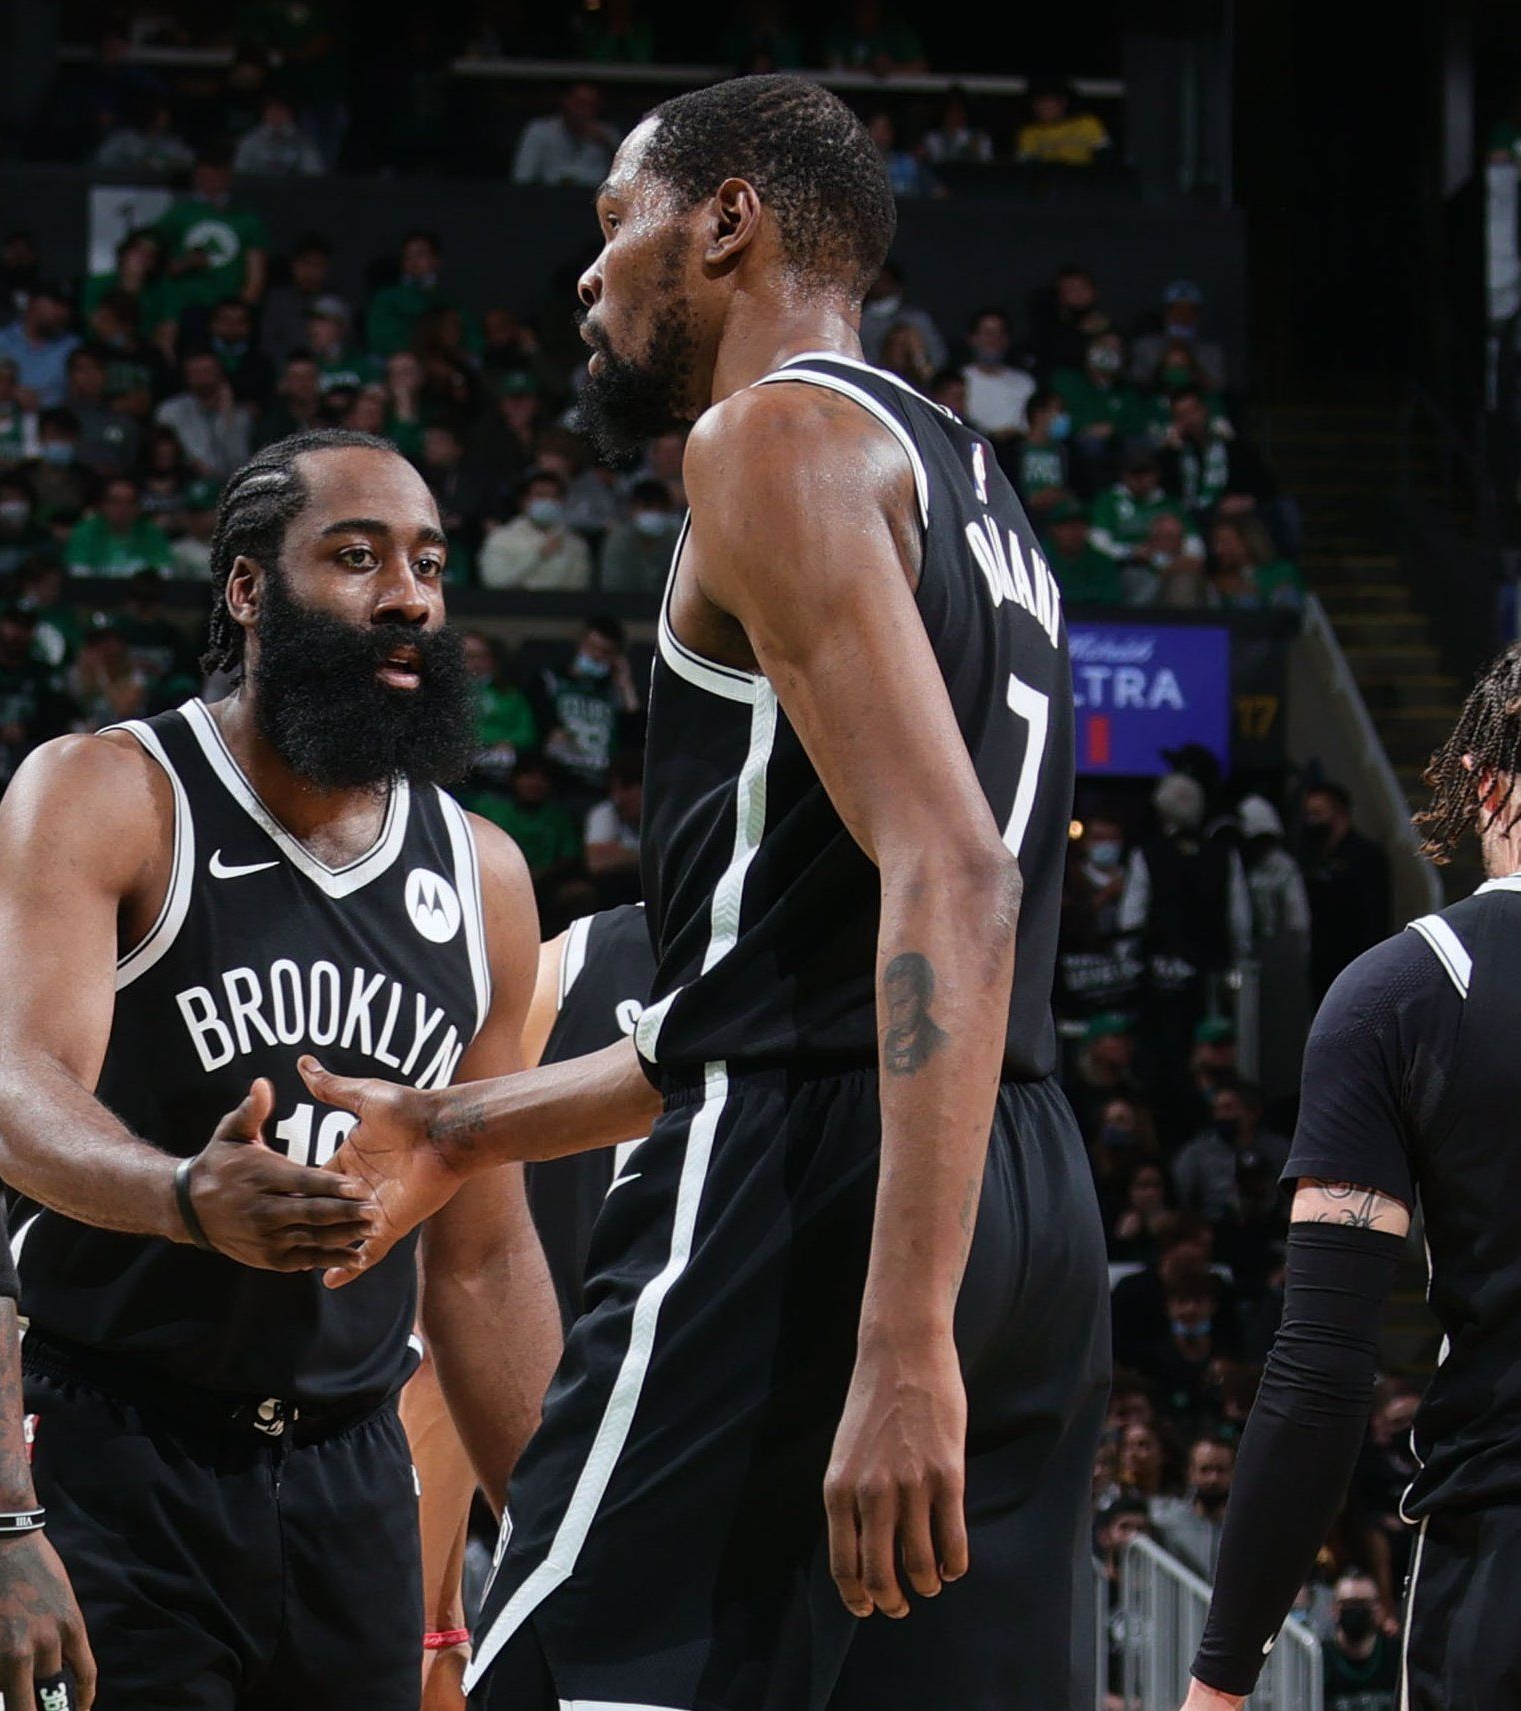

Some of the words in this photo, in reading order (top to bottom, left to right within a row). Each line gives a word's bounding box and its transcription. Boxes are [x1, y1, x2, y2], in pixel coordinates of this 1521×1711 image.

[1006, 672, 1050, 860] 7
[175, 958, 464, 1090] BROOKLYN
[39, 1681, 71, 1711] 36
